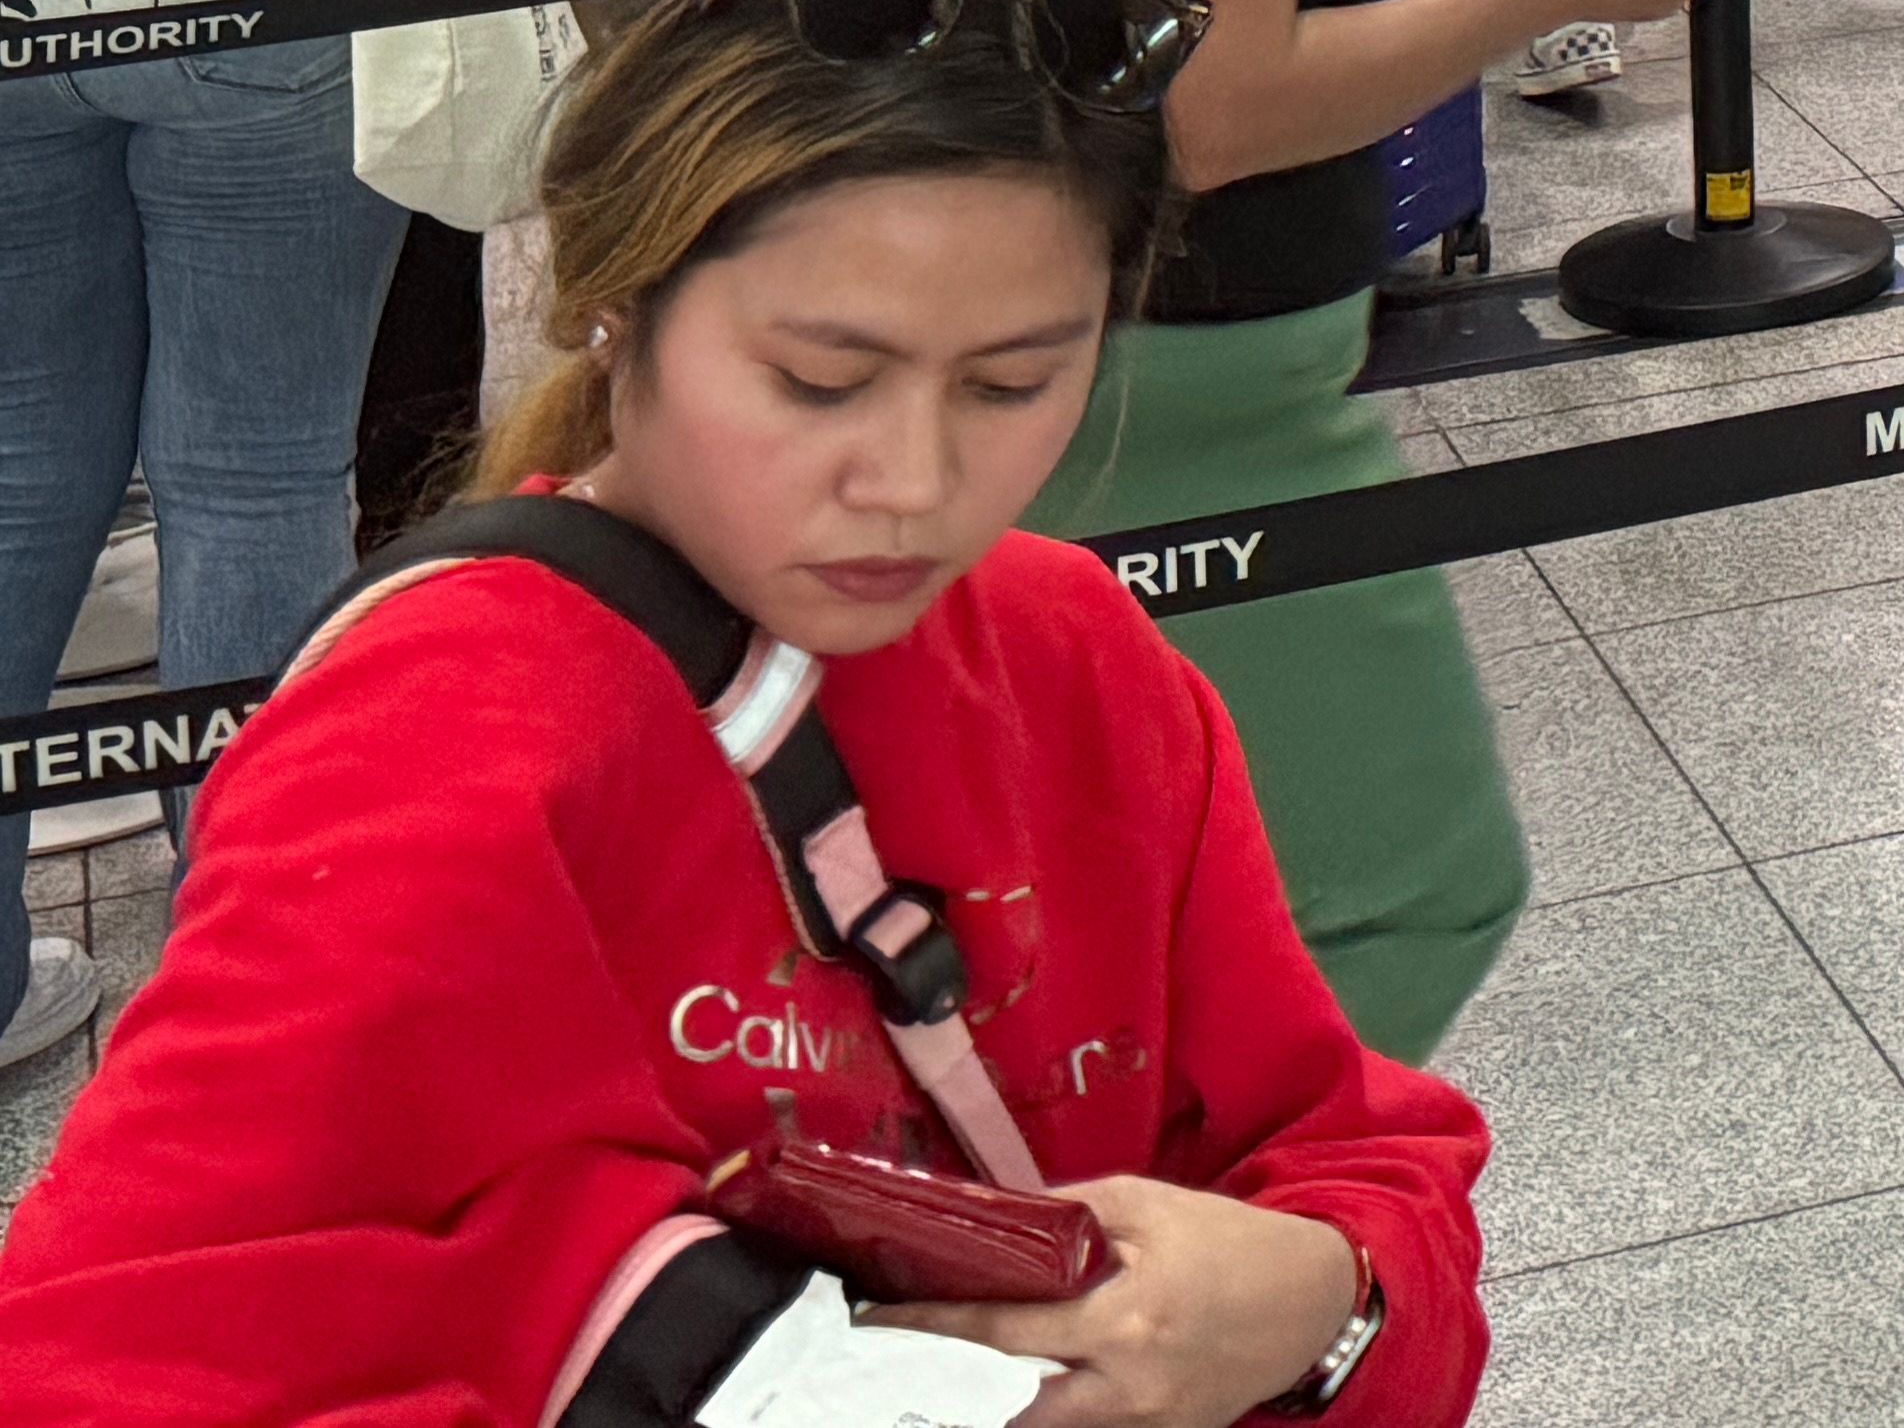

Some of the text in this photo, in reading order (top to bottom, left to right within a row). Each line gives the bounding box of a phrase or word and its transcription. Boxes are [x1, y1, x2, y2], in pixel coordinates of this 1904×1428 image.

[0, 11, 264, 68] UTHORITY
[1117, 530, 1265, 597] RITY
[0, 703, 261, 793] TERNA
